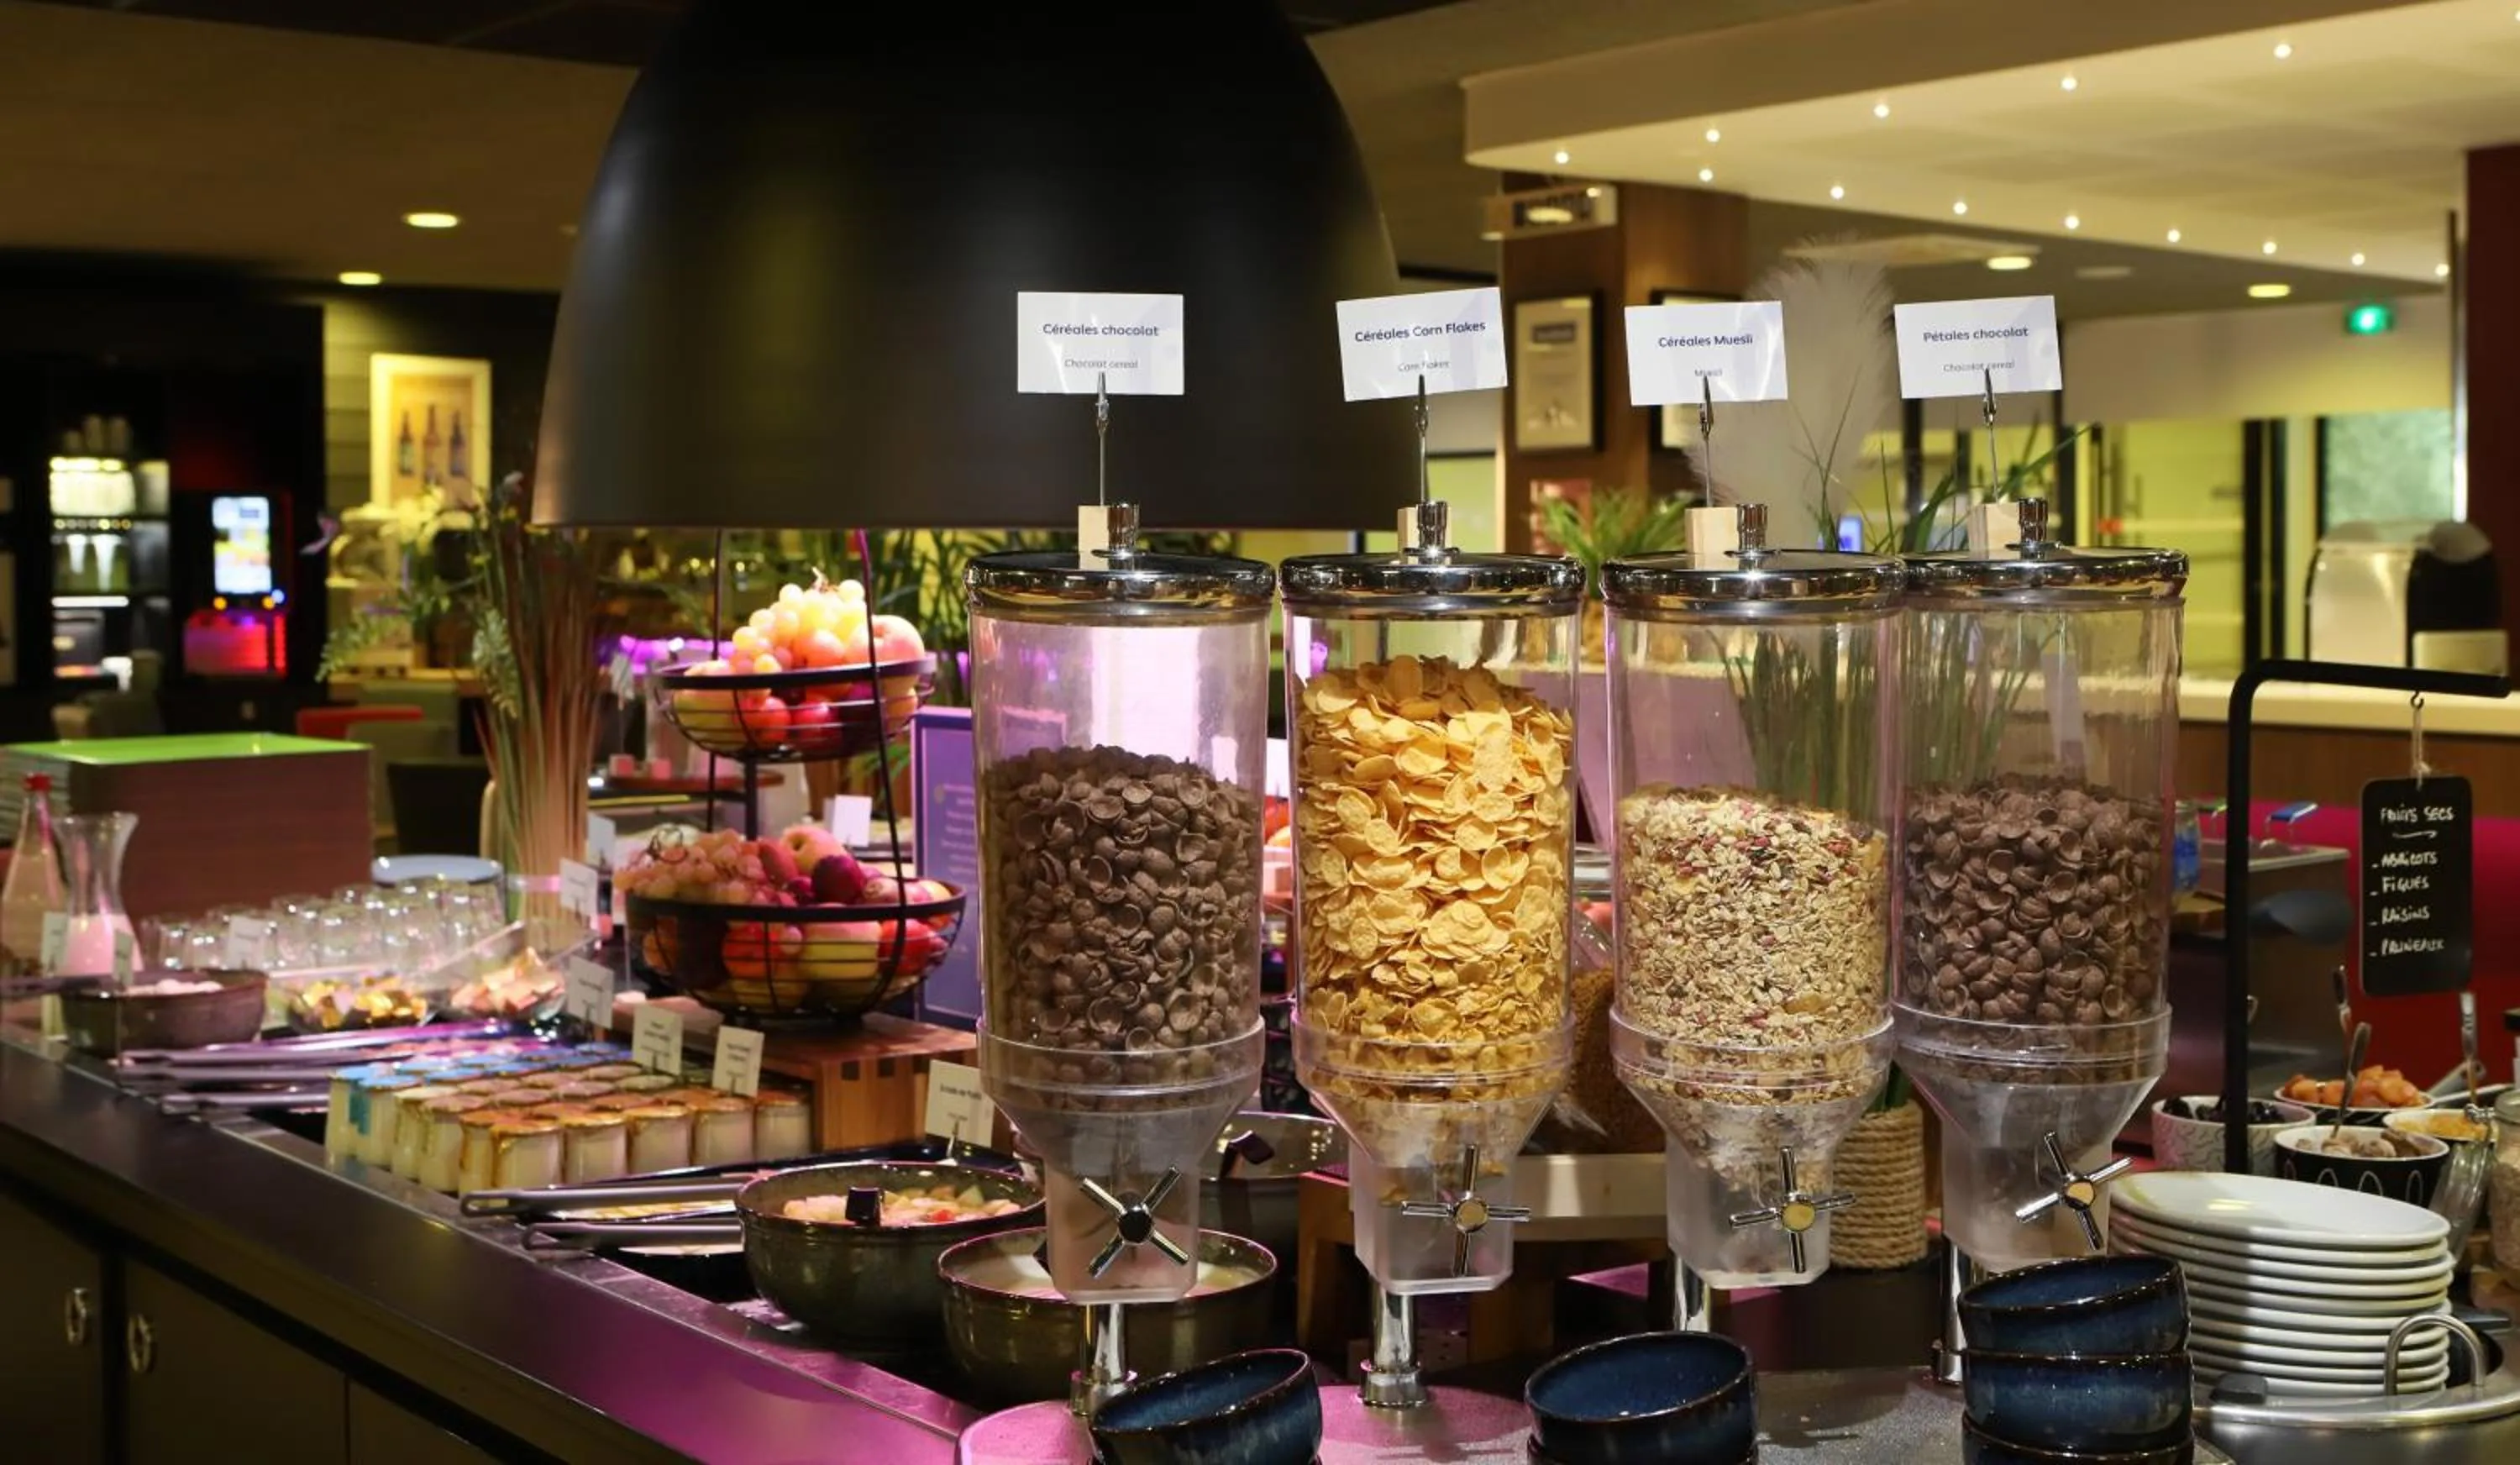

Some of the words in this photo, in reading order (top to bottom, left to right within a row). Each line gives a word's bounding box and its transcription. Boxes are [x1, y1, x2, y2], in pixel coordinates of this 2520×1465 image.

[1042, 323, 1099, 335] Céréales
[1101, 325, 1159, 336] chocolat
[1355, 328, 1410, 342] Céréales
[1412, 326, 1442, 337] Corn
[1446, 322, 1486, 333] Flakes
[1923, 331, 1970, 343] Pétales
[1972, 327, 2029, 339] chocolat
[1658, 336, 1711, 347] Céréales
[1714, 334, 1753, 345] Muesli
[2423, 806, 2454, 821] SECS
